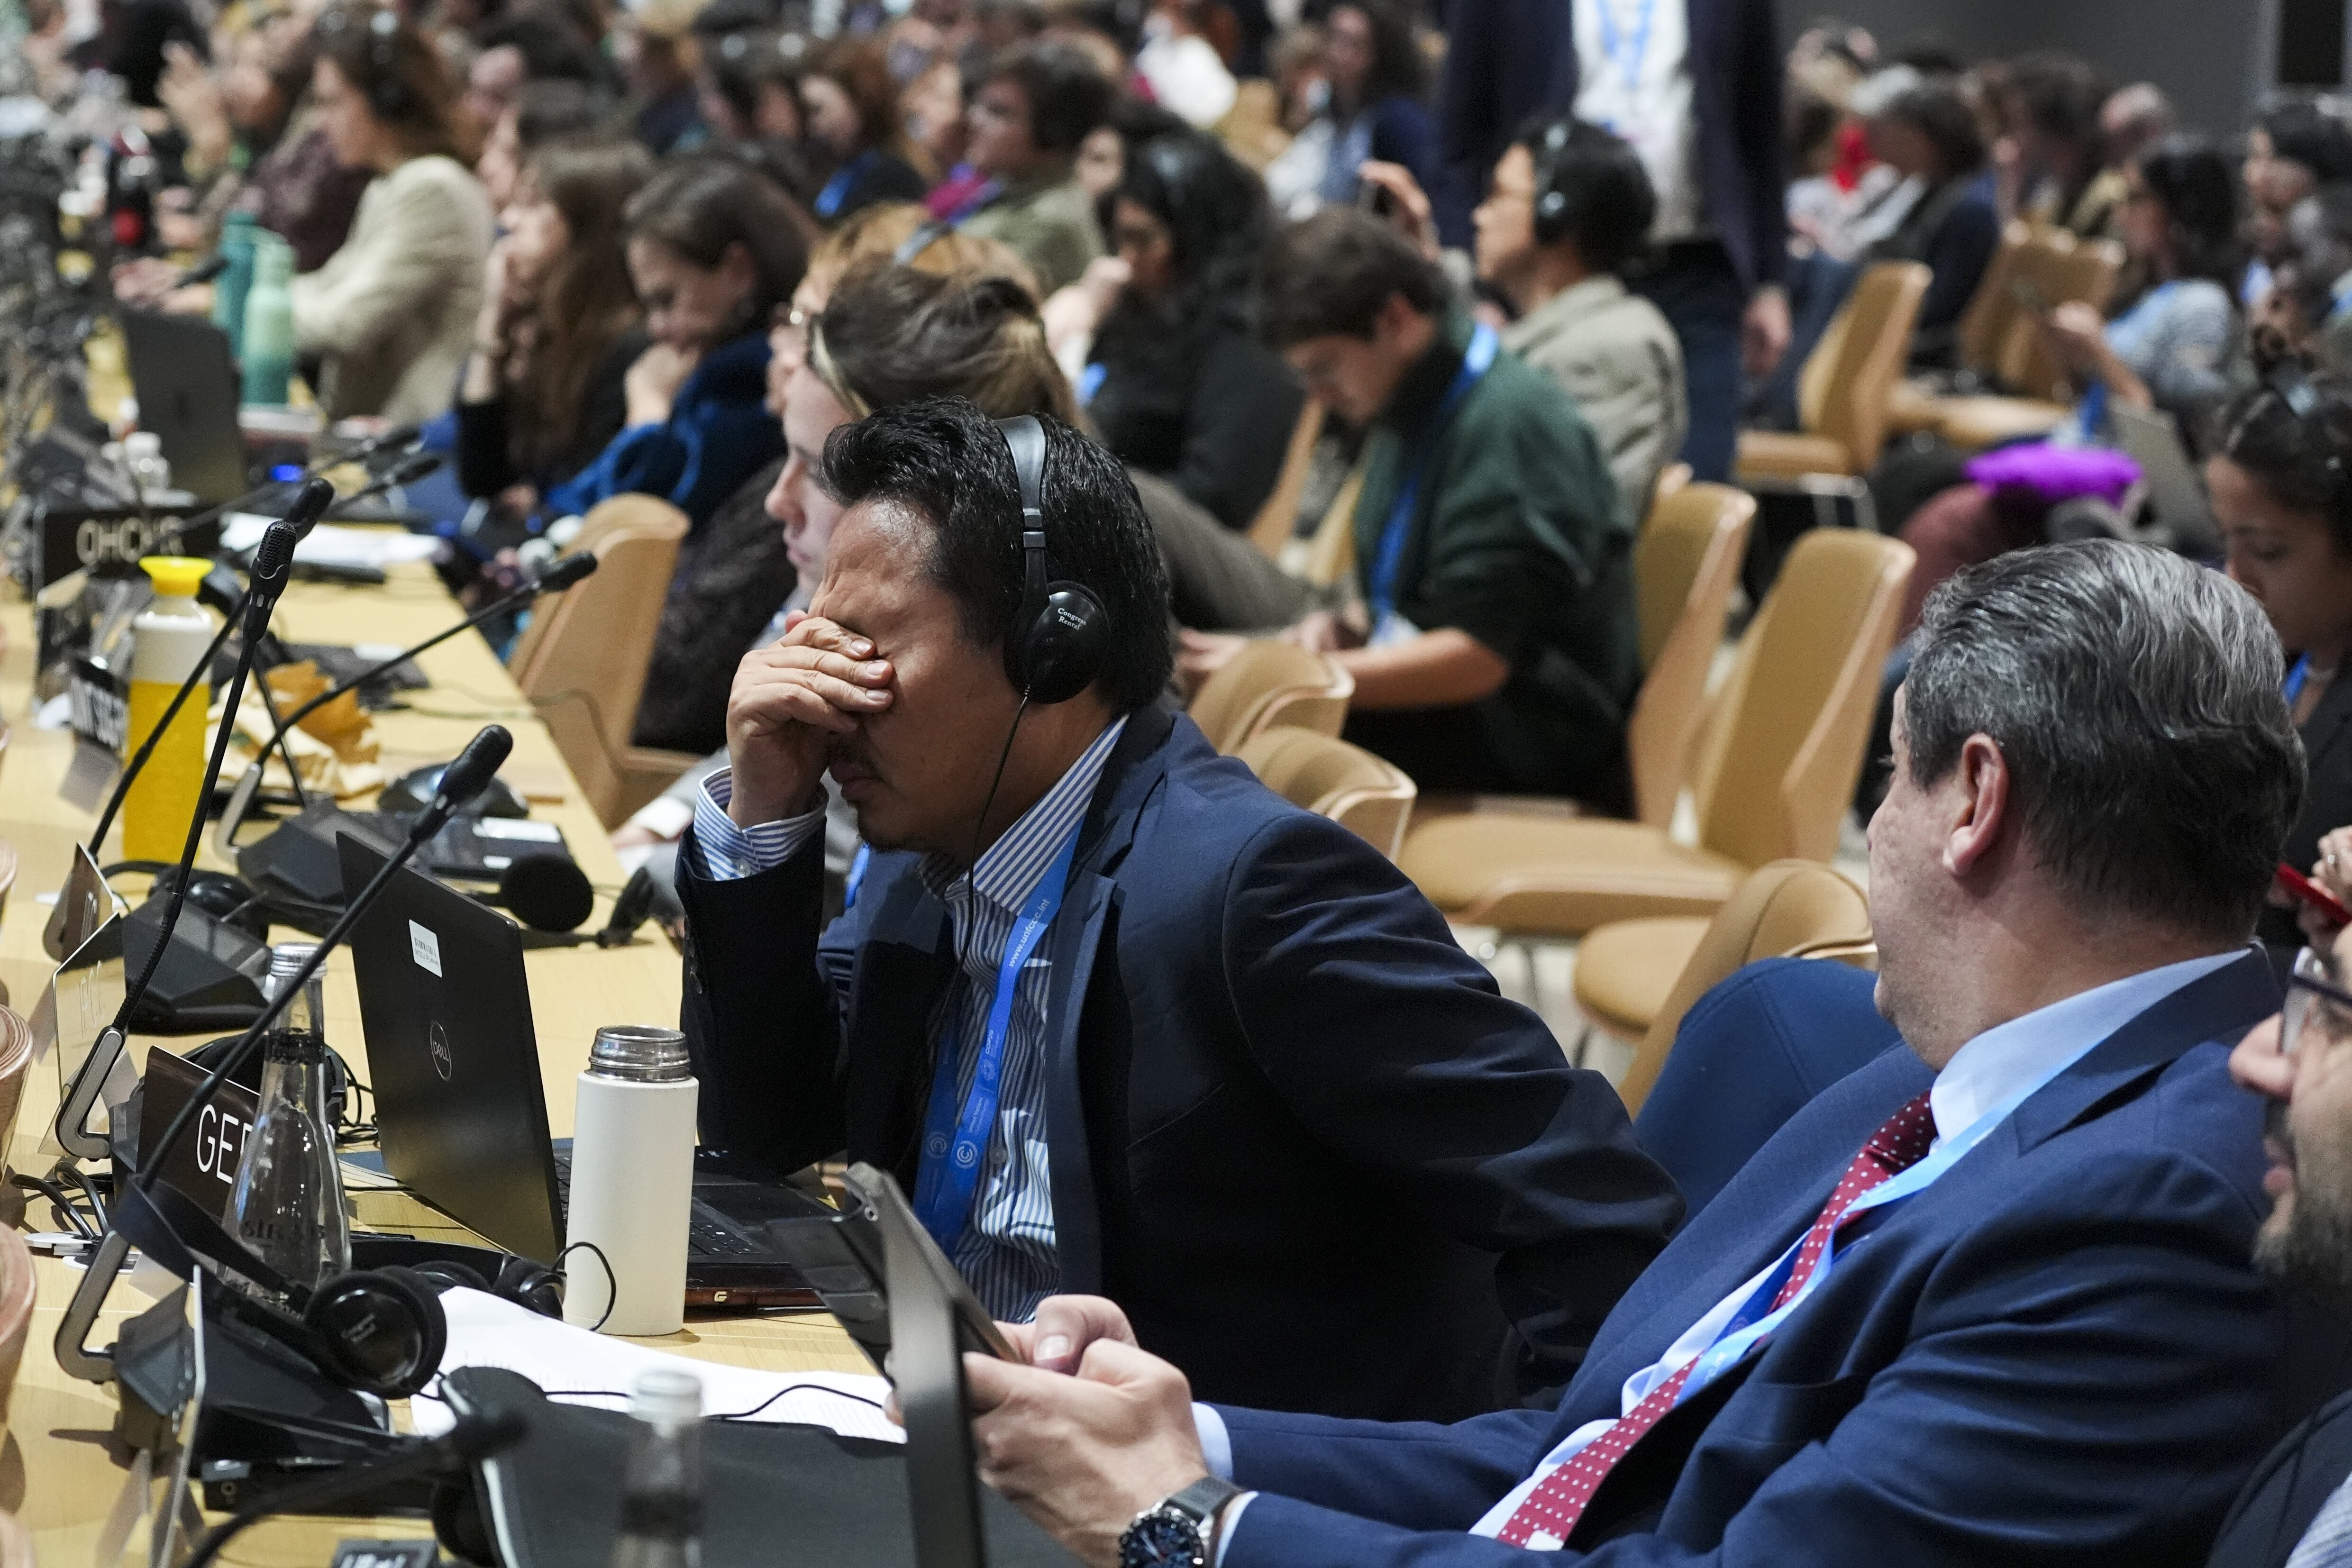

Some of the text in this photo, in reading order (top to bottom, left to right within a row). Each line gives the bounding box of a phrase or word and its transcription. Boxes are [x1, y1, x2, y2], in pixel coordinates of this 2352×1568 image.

[1057, 608, 1086, 626] Congress
[1058, 615, 1080, 630] Rental
[197, 1104, 253, 1184] GE
